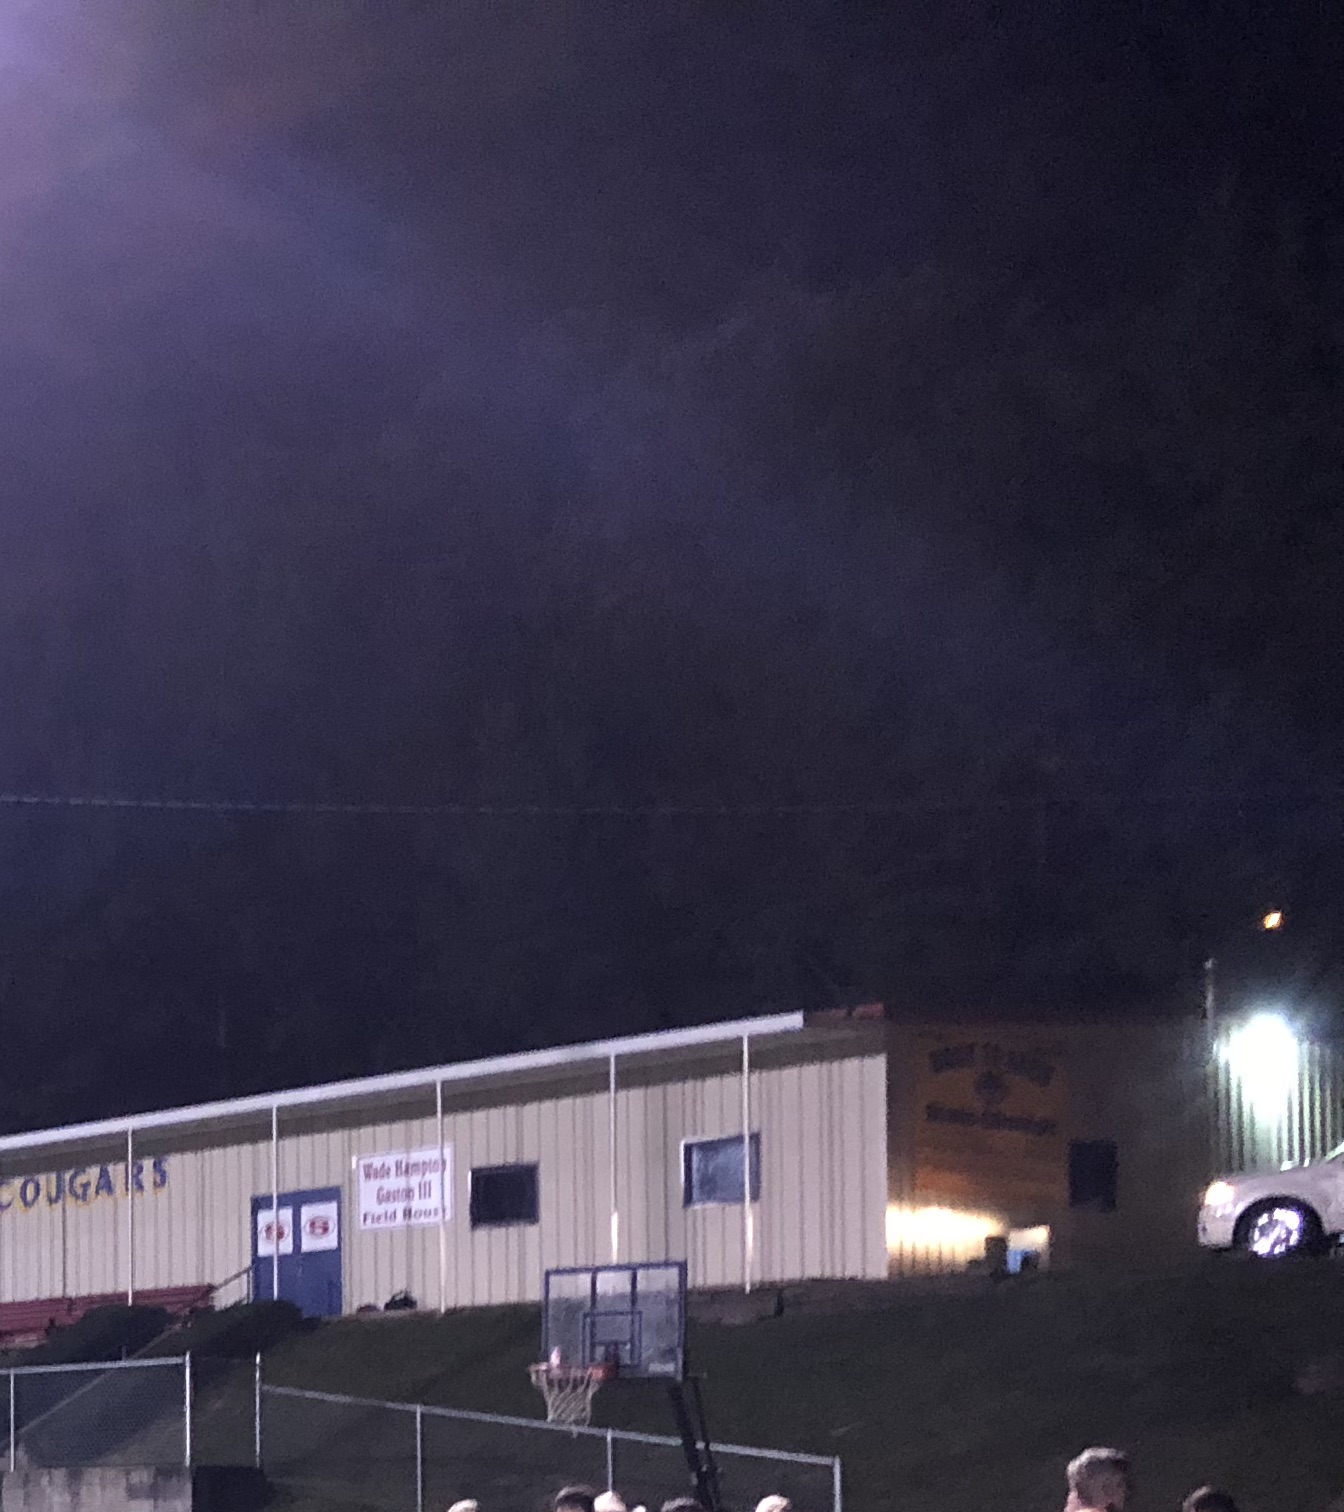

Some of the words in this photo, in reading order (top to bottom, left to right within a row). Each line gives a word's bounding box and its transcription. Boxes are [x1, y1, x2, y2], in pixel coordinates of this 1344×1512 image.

[363, 1161, 391, 1181] Wade
[395, 1158, 446, 1178] Hampton
[376, 1183, 415, 1205] Gaston
[363, 1209, 397, 1225] Field
